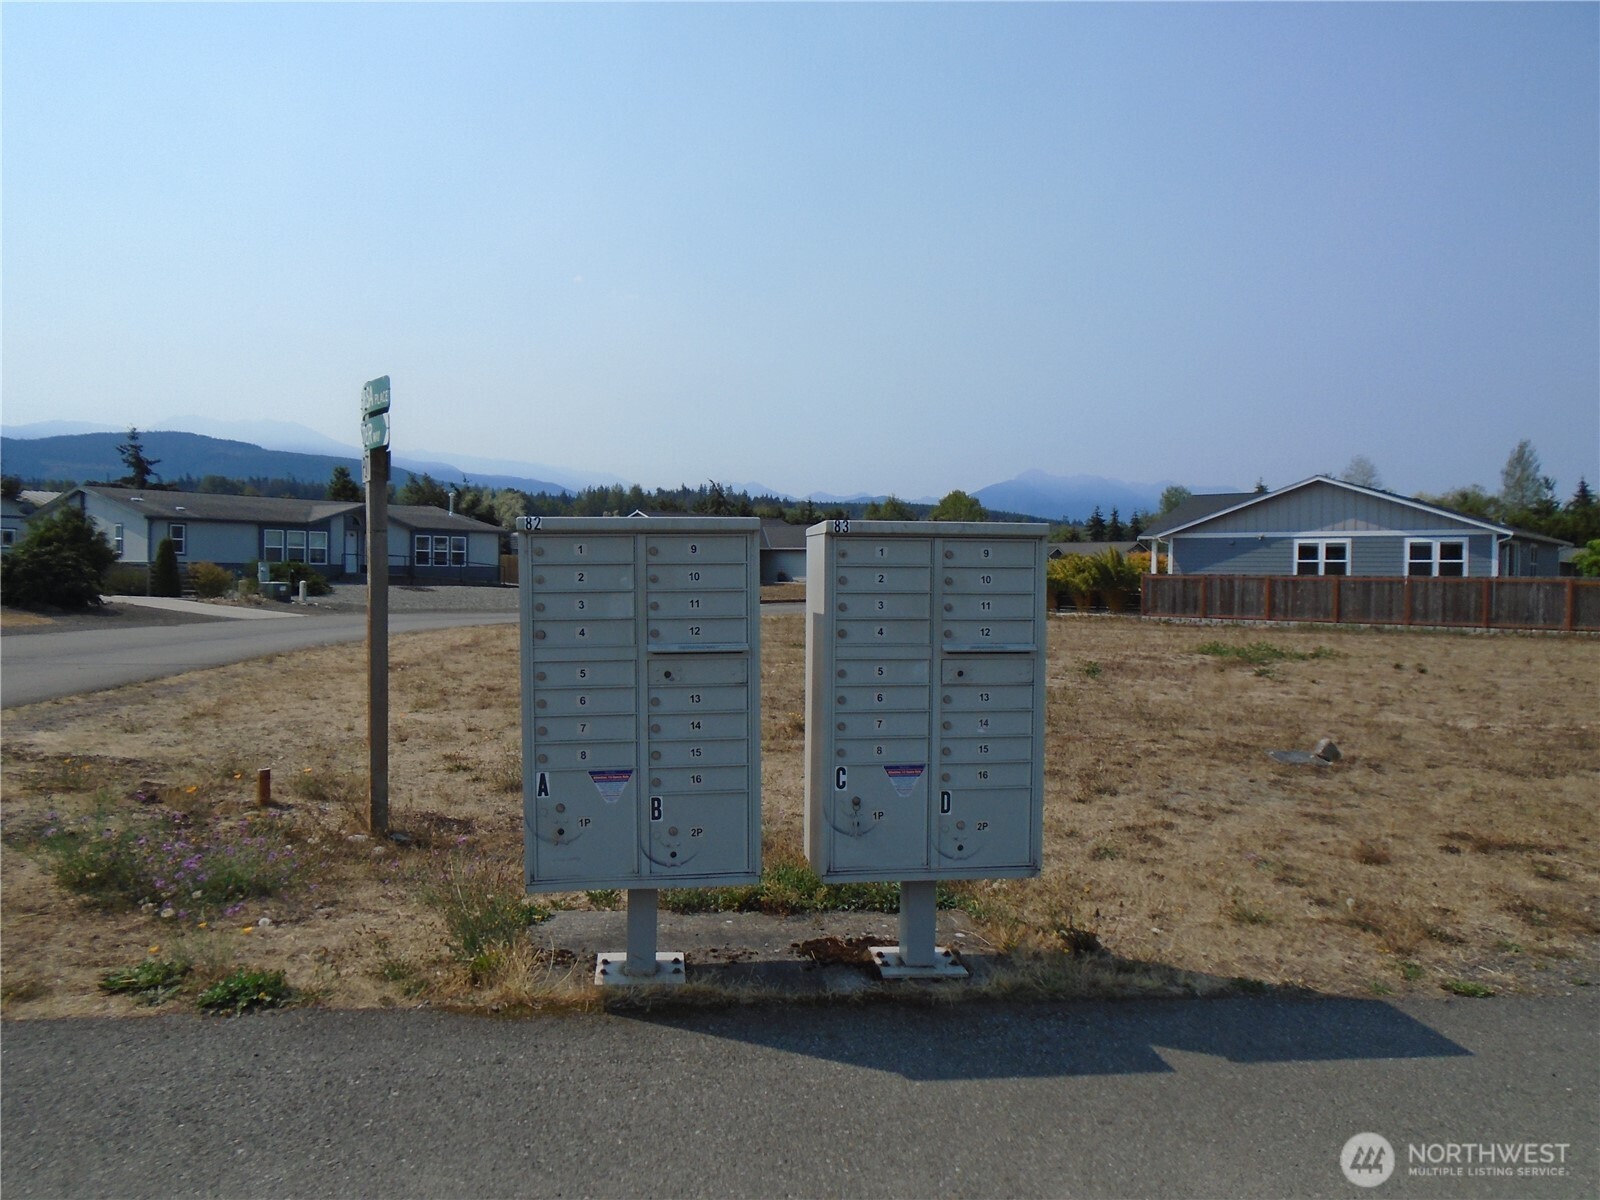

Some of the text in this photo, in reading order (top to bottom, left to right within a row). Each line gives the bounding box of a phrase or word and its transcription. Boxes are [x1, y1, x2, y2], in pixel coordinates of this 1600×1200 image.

[524, 517, 541, 531] 82
[834, 520, 849, 533] 83
[578, 545, 583, 554] 1
[690, 544, 697, 554] 9
[879, 548, 884, 557] 1
[983, 549, 990, 558] 9
[578, 572, 585, 582] 2
[689, 572, 700, 581] 10
[878, 574, 884, 583] 2
[981, 575, 992, 584] 10
[578, 600, 585, 610] 3
[690, 599, 700, 608] 11
[878, 600, 884, 610] 3
[981, 601, 990, 610] 11
[578, 628, 585, 637] 4
[689, 626, 701, 636] 12
[877, 627, 884, 636] 4
[980, 627, 991, 637] 12
[580, 669, 586, 679] 5
[877, 667, 884, 676] 5
[579, 696, 586, 706] 6
[690, 694, 701, 704] 13
[877, 693, 883, 702] 6
[979, 693, 990, 702] 13
[690, 721, 701, 730] 14
[877, 720, 883, 728] 7
[979, 719, 989, 727] 14
[580, 723, 587, 733] 7
[690, 748, 702, 757] 15
[876, 746, 883, 755] 8
[979, 744, 989, 753] 15
[580, 750, 587, 760] 8
[691, 774, 702, 784] 16
[836, 766, 847, 789] C
[978, 770, 989, 779] 16
[537, 773, 549, 797] A
[940, 791, 951, 813] D
[651, 797, 662, 821] B
[873, 811, 884, 820] 1P
[579, 818, 591, 827] 1P
[977, 822, 989, 831] 2P
[691, 828, 703, 837] 2P
